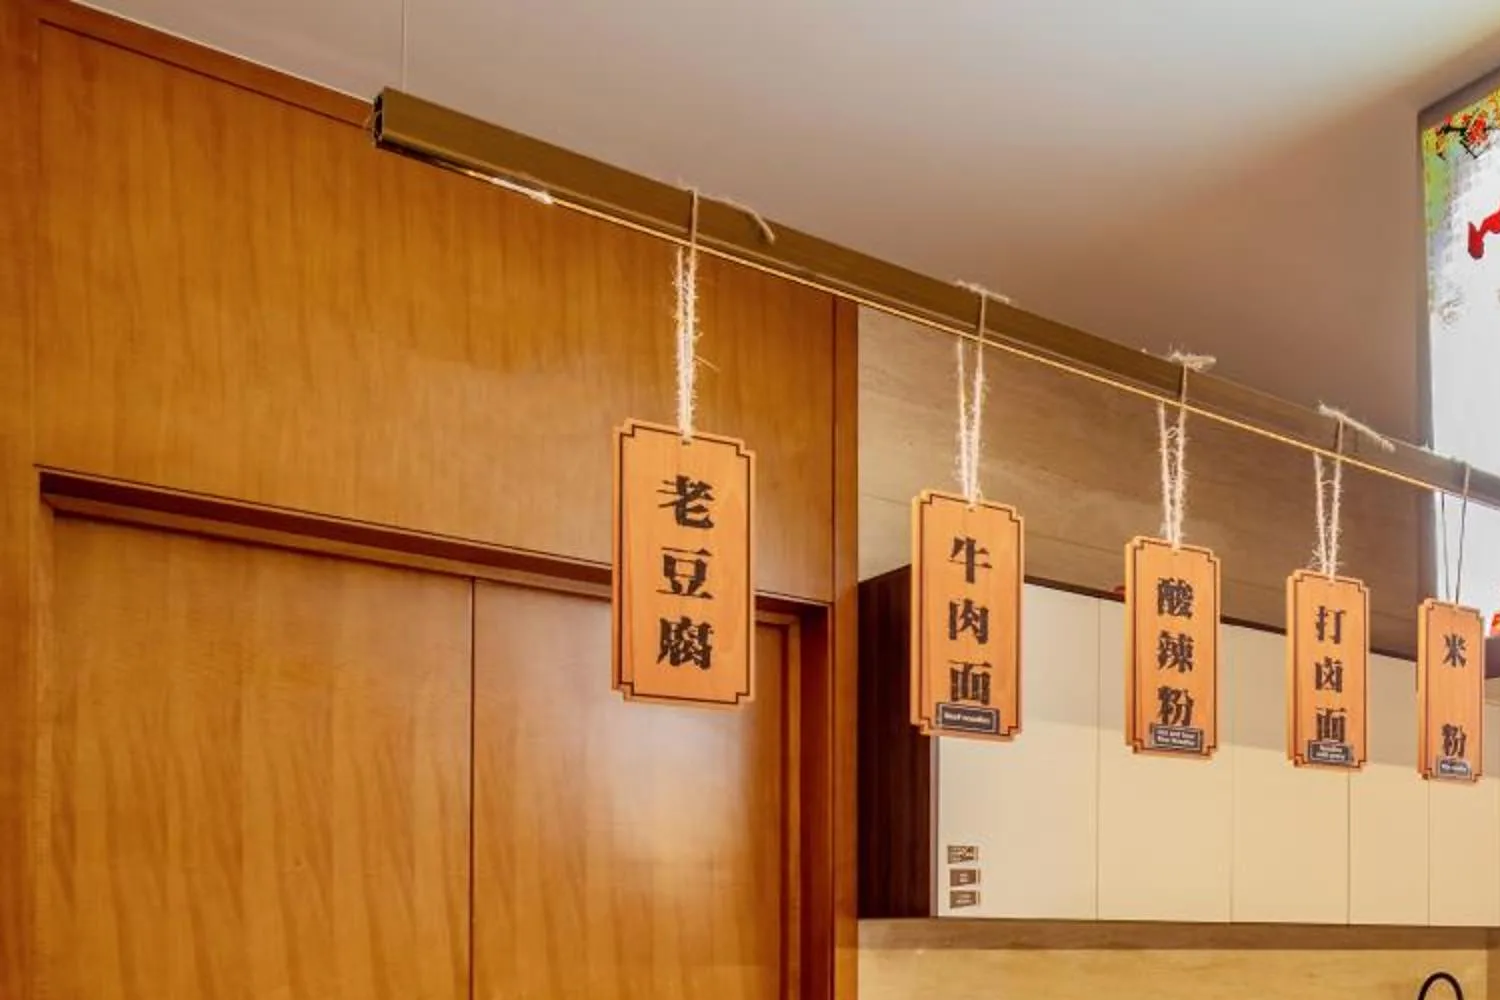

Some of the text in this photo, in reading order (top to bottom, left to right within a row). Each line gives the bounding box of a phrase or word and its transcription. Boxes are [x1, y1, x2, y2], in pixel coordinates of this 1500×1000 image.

[656, 475, 714, 671] 老豆腐
[948, 536, 992, 706] 牛肉面
[1156, 576, 1195, 727] 酸辣粉
[1314, 605, 1348, 743] 打卤面
[1441, 633, 1468, 758] 米粉
